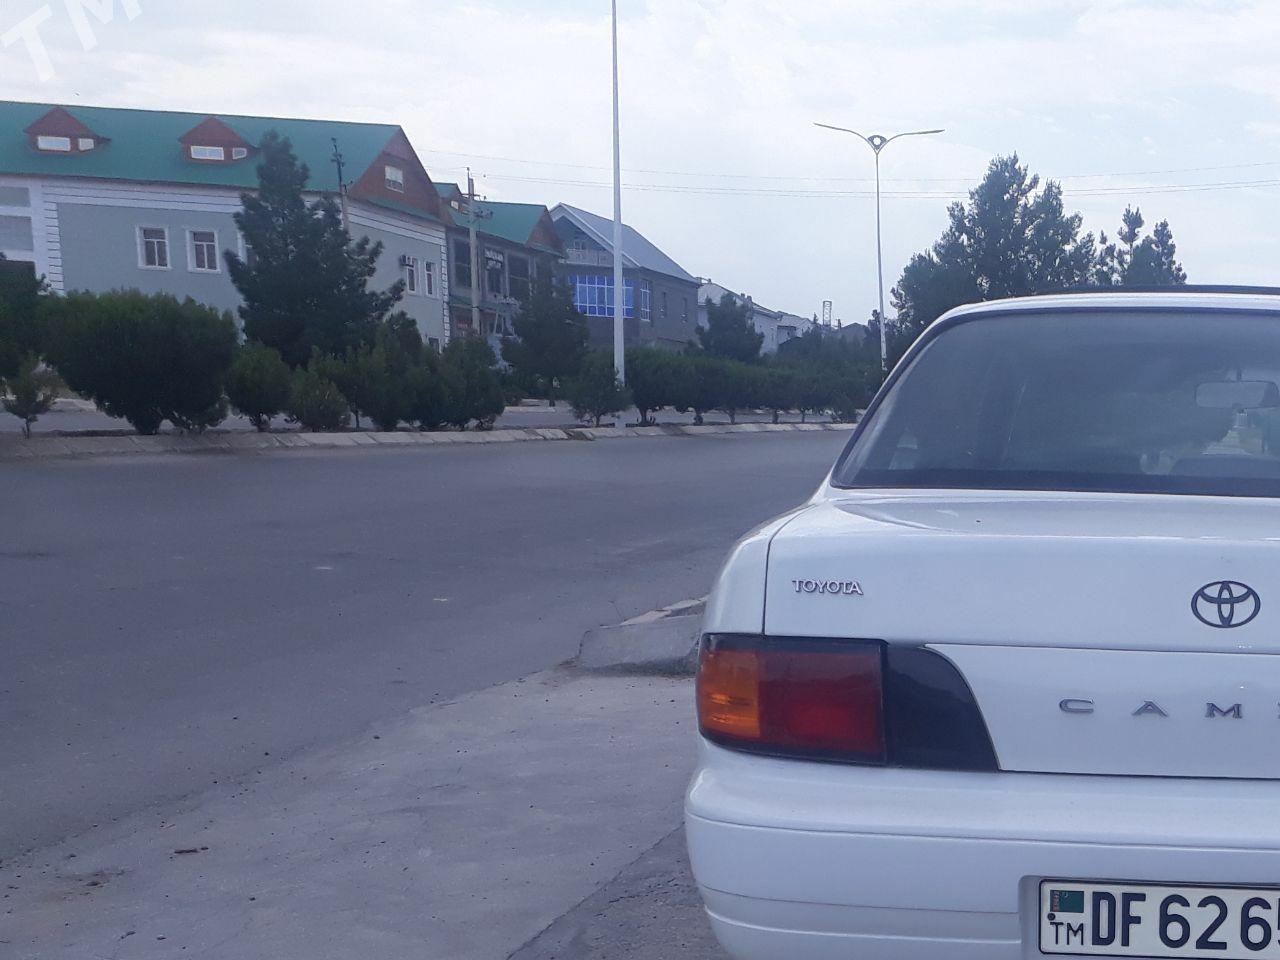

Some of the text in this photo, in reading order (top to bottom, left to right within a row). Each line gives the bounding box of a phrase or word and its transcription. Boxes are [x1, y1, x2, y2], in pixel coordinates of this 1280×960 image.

[792, 579, 864, 596] TOYOTA
[1091, 891, 1146, 947] DF
[1050, 921, 1084, 946] TM
